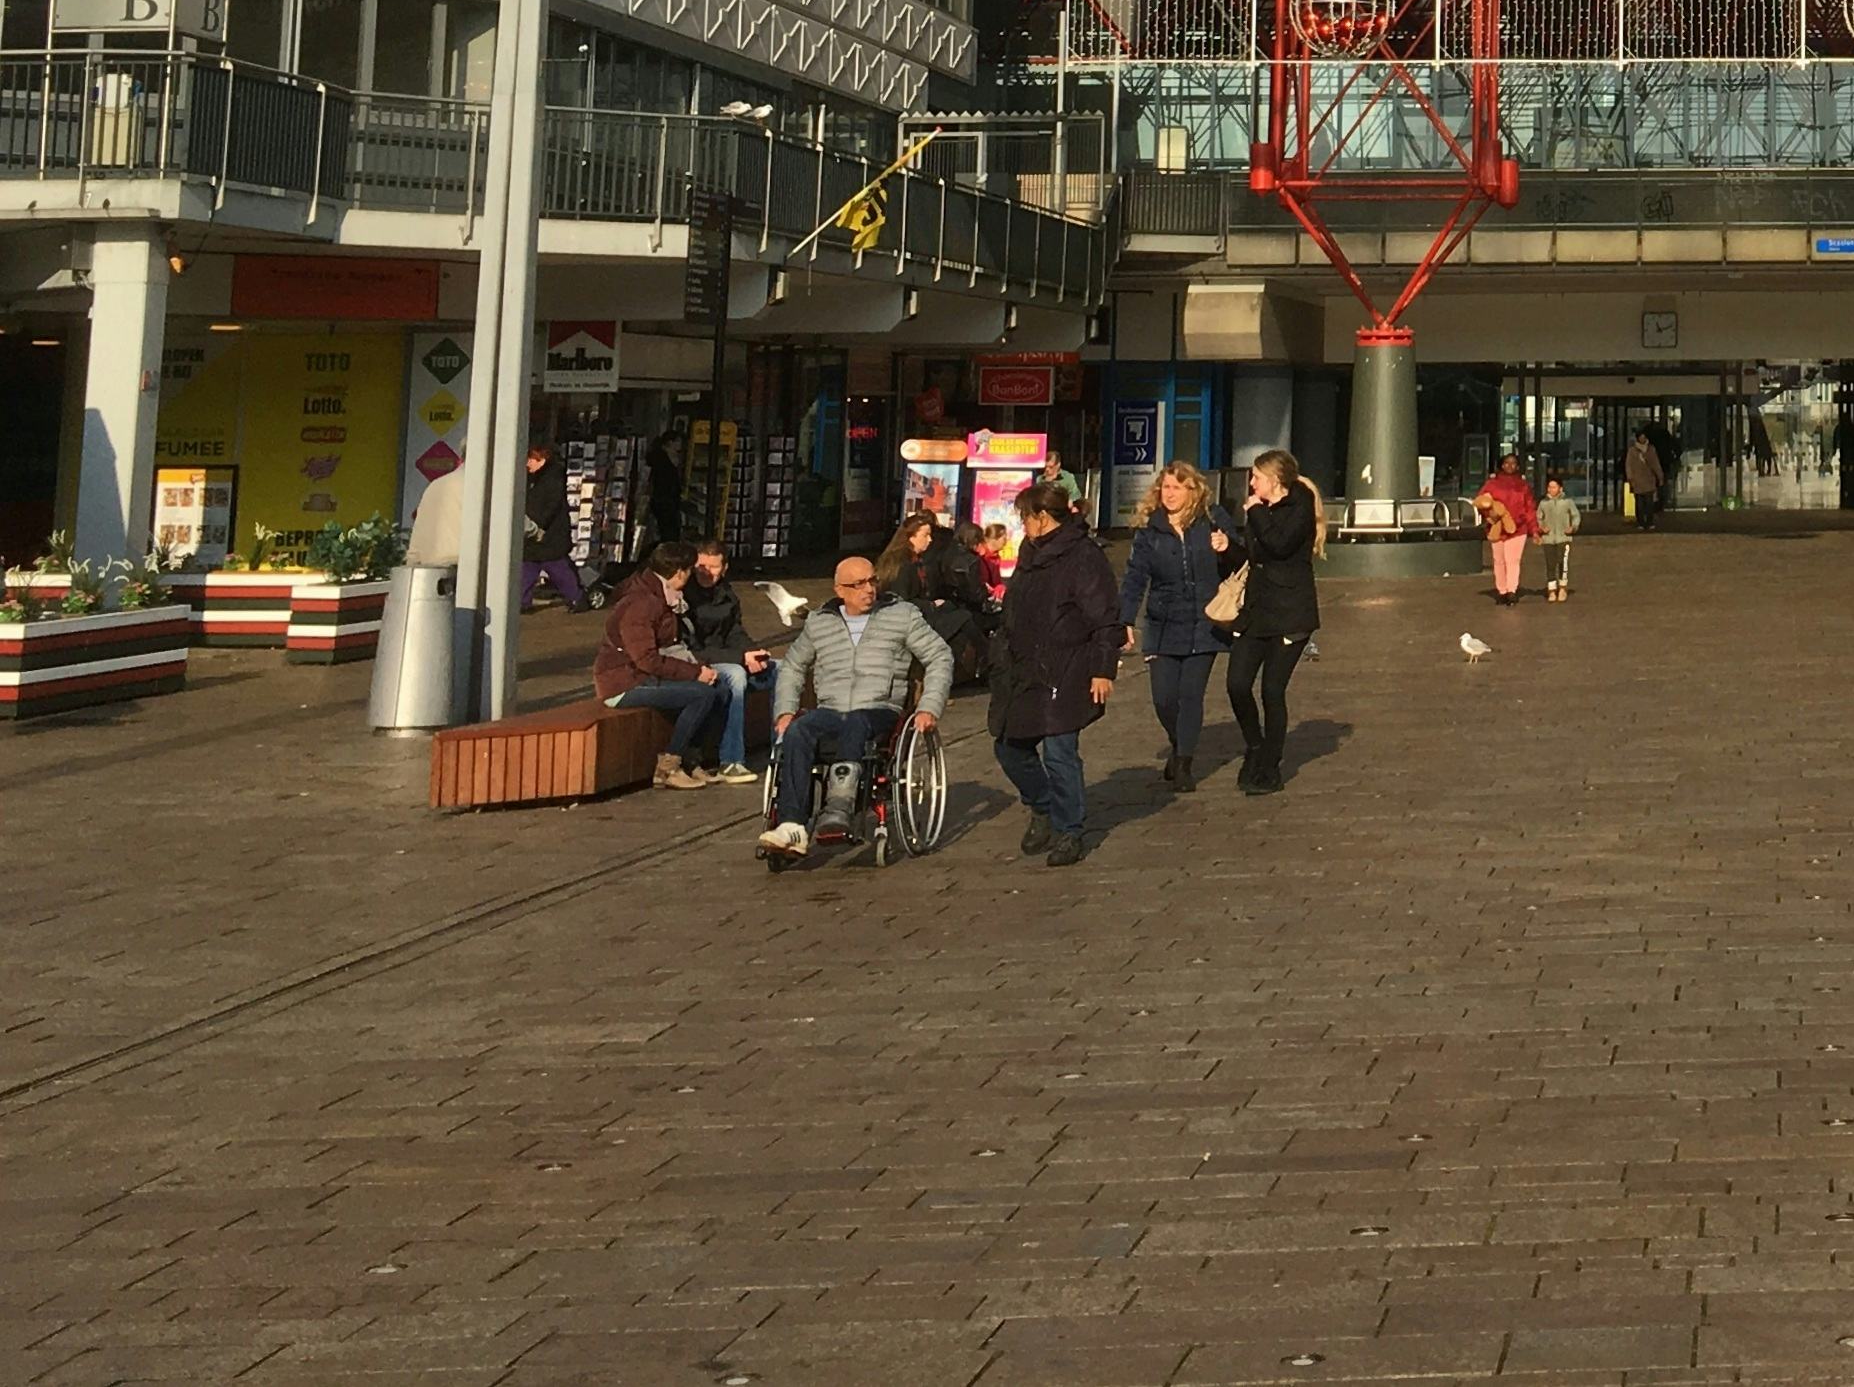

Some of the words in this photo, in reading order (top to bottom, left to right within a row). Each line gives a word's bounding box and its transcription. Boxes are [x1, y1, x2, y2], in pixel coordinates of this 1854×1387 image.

[305, 353, 350, 372] TOTO
[432, 356, 459, 369] TOTO
[547, 347, 613, 371] Marlboro
